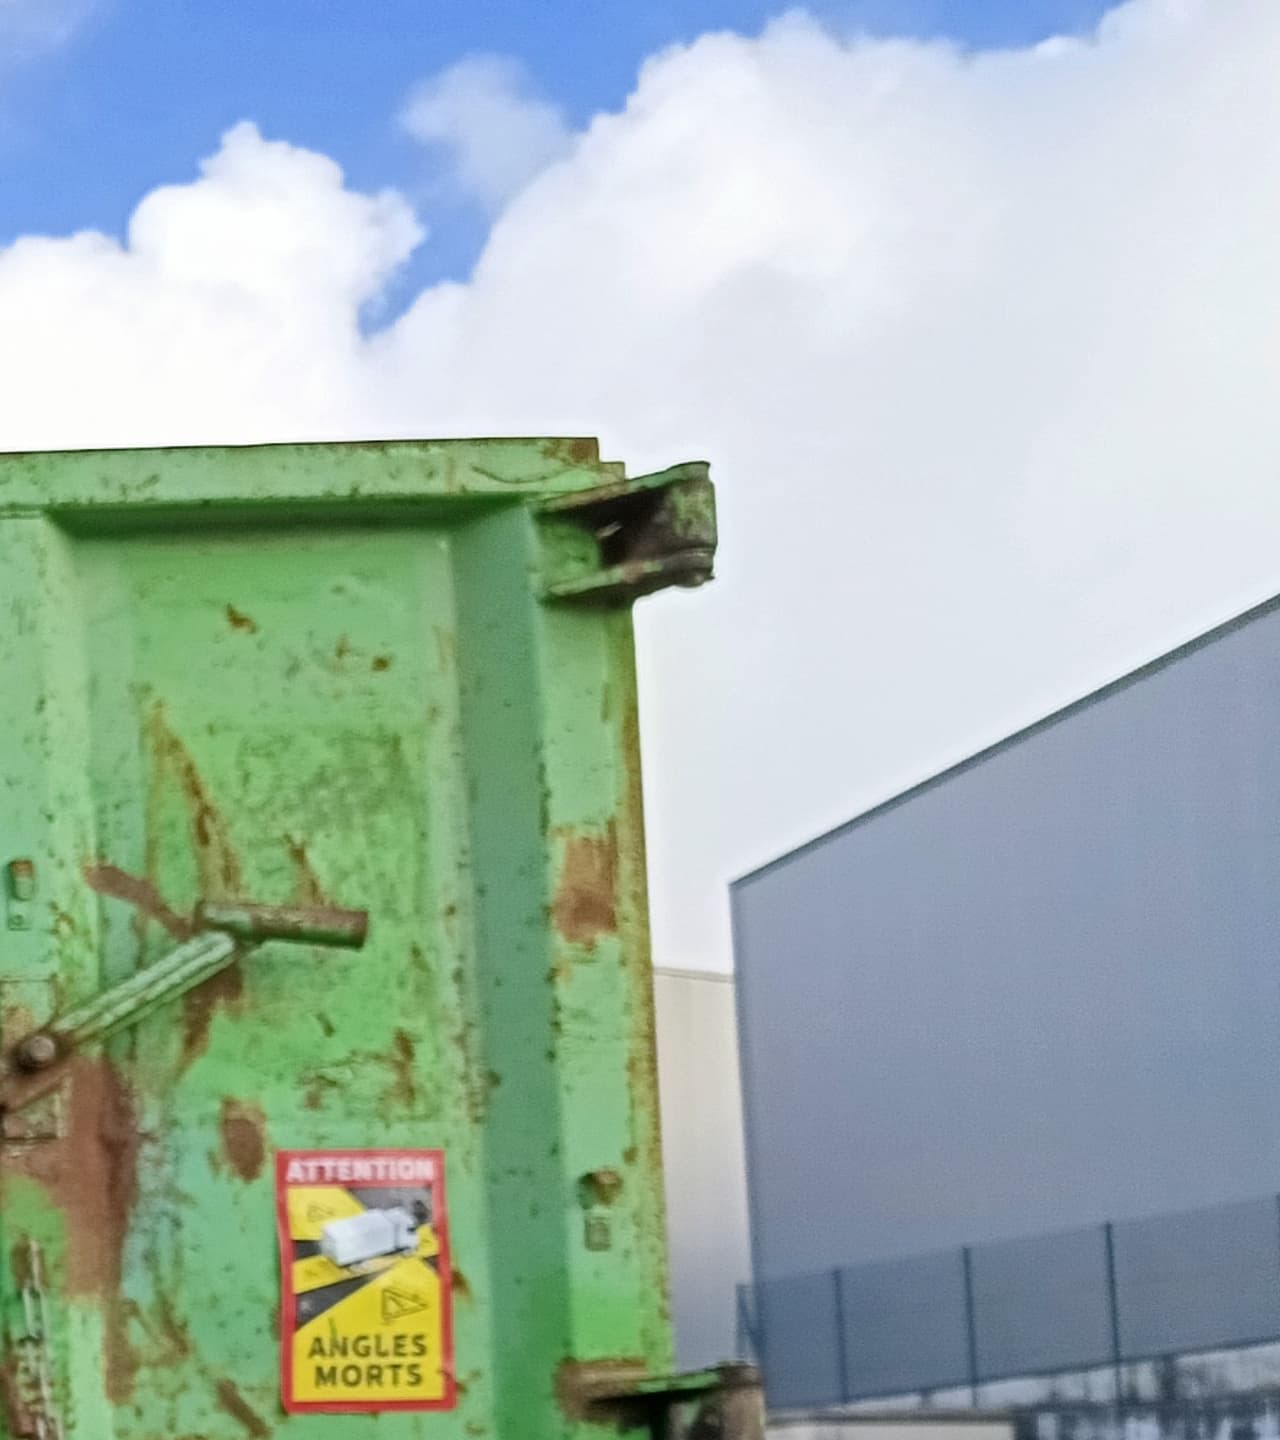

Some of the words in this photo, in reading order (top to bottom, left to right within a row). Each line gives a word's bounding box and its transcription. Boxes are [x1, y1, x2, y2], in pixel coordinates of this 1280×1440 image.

[286, 1158, 435, 1182] ATTENTION
[307, 1333, 428, 1359] ANGLES
[314, 1363, 423, 1388] MORTS
